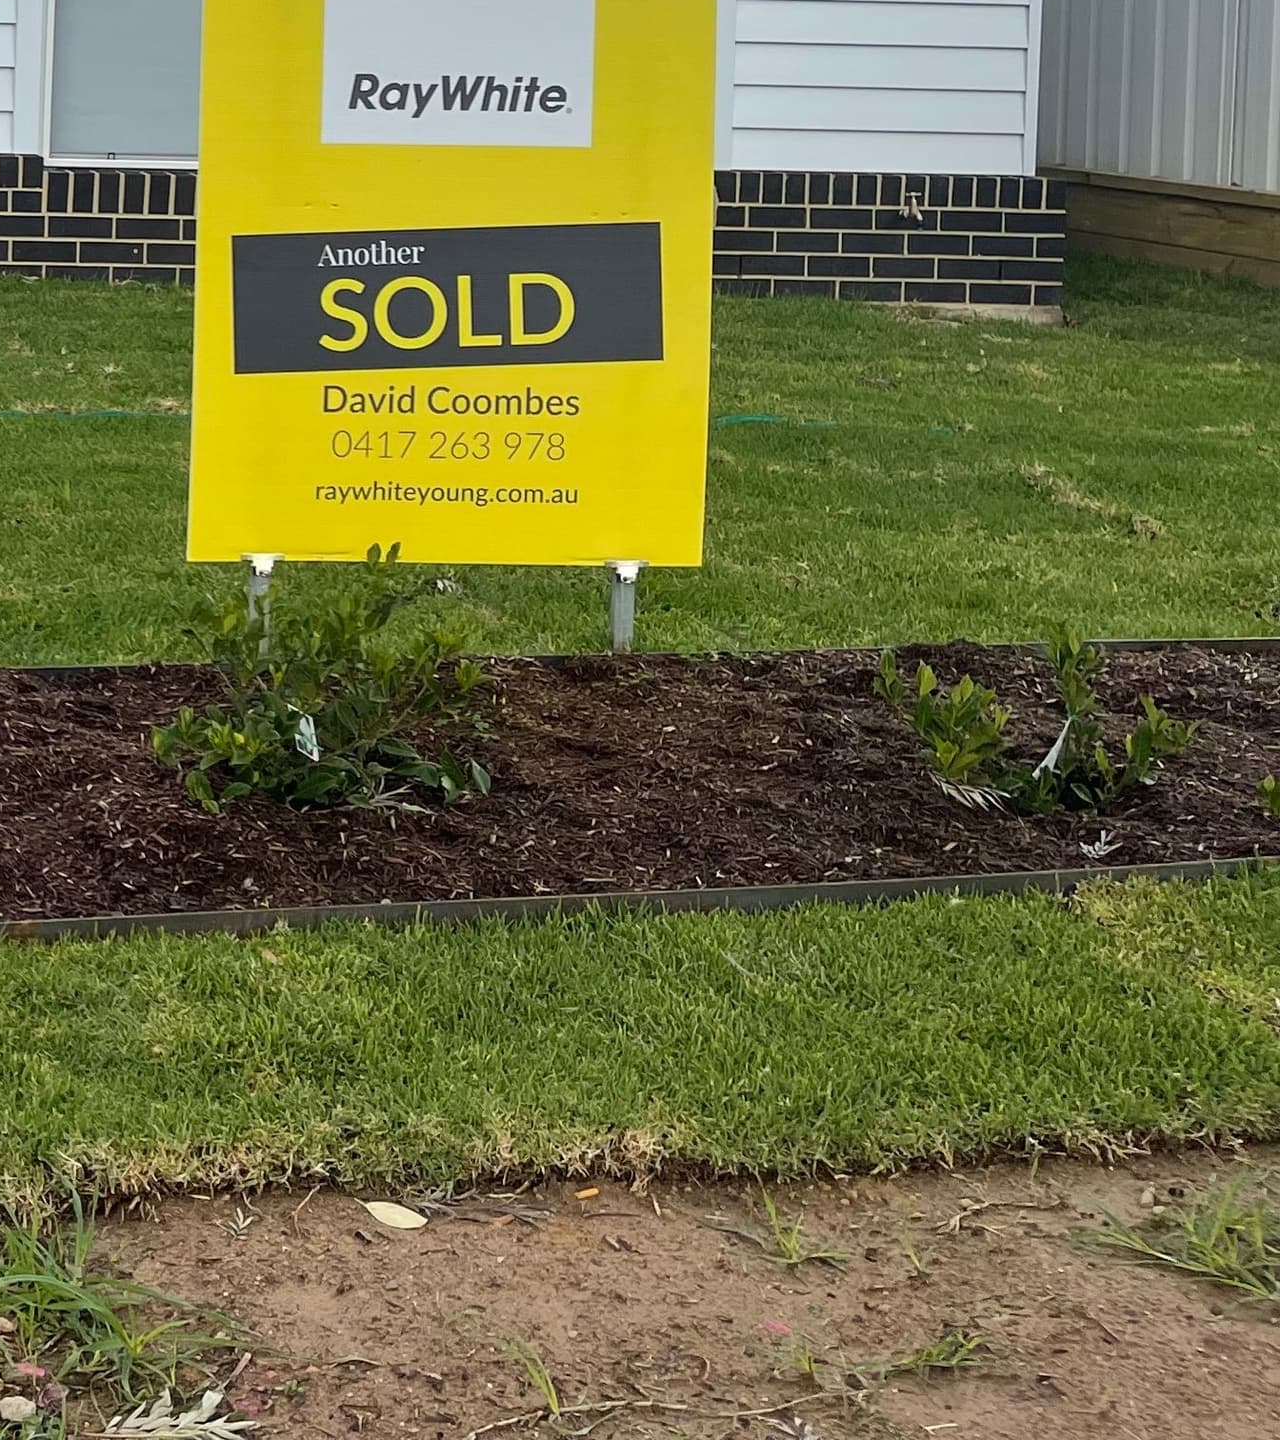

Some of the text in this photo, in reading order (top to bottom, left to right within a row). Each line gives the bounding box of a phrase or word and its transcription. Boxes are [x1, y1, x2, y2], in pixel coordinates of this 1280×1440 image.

[317, 240, 424, 267] Another
[319, 273, 575, 352] SOLD
[323, 385, 580, 416] David Coombes
[332, 430, 565, 461] 0417 263 978
[315, 481, 578, 507] raywhiteyoung.com.au
